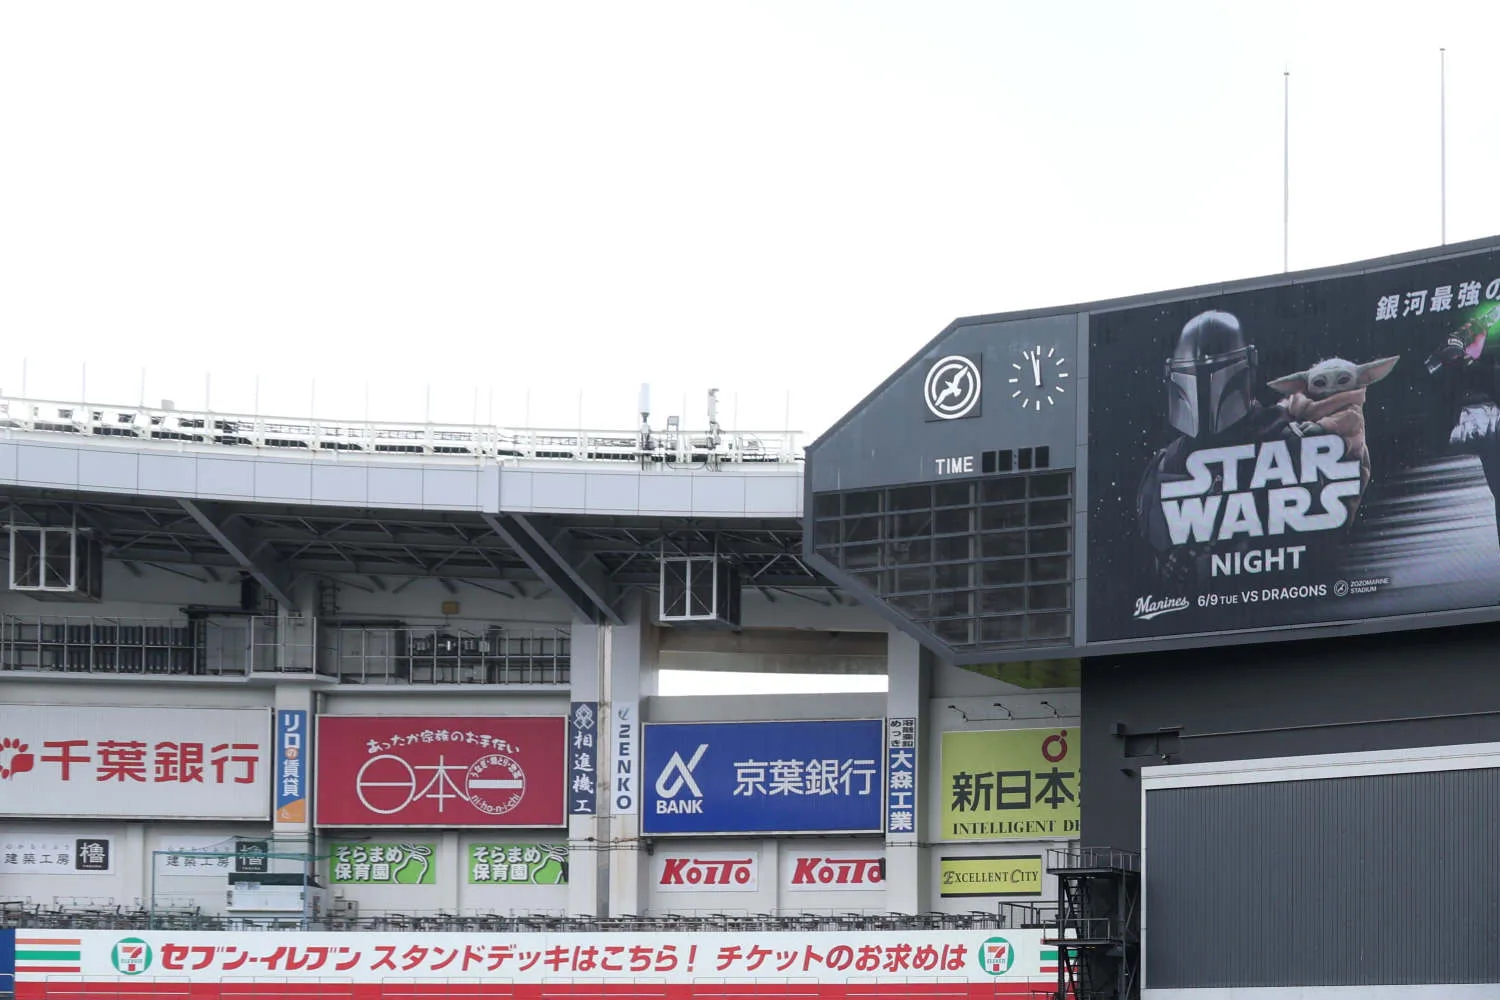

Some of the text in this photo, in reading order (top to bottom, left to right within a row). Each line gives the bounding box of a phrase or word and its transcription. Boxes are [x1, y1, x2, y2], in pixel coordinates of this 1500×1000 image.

[935, 456, 974, 475] TIME
[1161, 434, 1361, 498] STAR
[1161, 480, 1361, 545] WARS
[1211, 545, 1306, 577] NIGHT
[1197, 594, 1218, 608] 6/9
[1220, 595, 1238, 605] TUE
[1241, 590, 1259, 603] VS
[1262, 584, 1328, 601] DRAGONS
[282, 714, 300, 797] リロの賃貸
[366, 730, 520, 754] あったか家族のお手伝い
[41, 740, 259, 783] 千葉銀行
[572, 731, 594, 813] 相進機工
[616, 724, 632, 810] ZENKO
[733, 759, 876, 796] 京葉銀行
[890, 750, 913, 831] 大森工業
[952, 767, 1081, 813] 新日本
[656, 800, 704, 815] BANK
[953, 820, 1056, 835] INTELLIGENT
[335, 847, 403, 862] そらまめ
[473, 847, 541, 862] そらまめ
[334, 862, 390, 881] 保育園
[472, 862, 528, 881] 保育園
[944, 869, 1039, 884] EXCELLENT CITY
[370, 943, 697, 972] スタンドデッキはこちら！
[717, 943, 967, 972] チケットのお求めは
